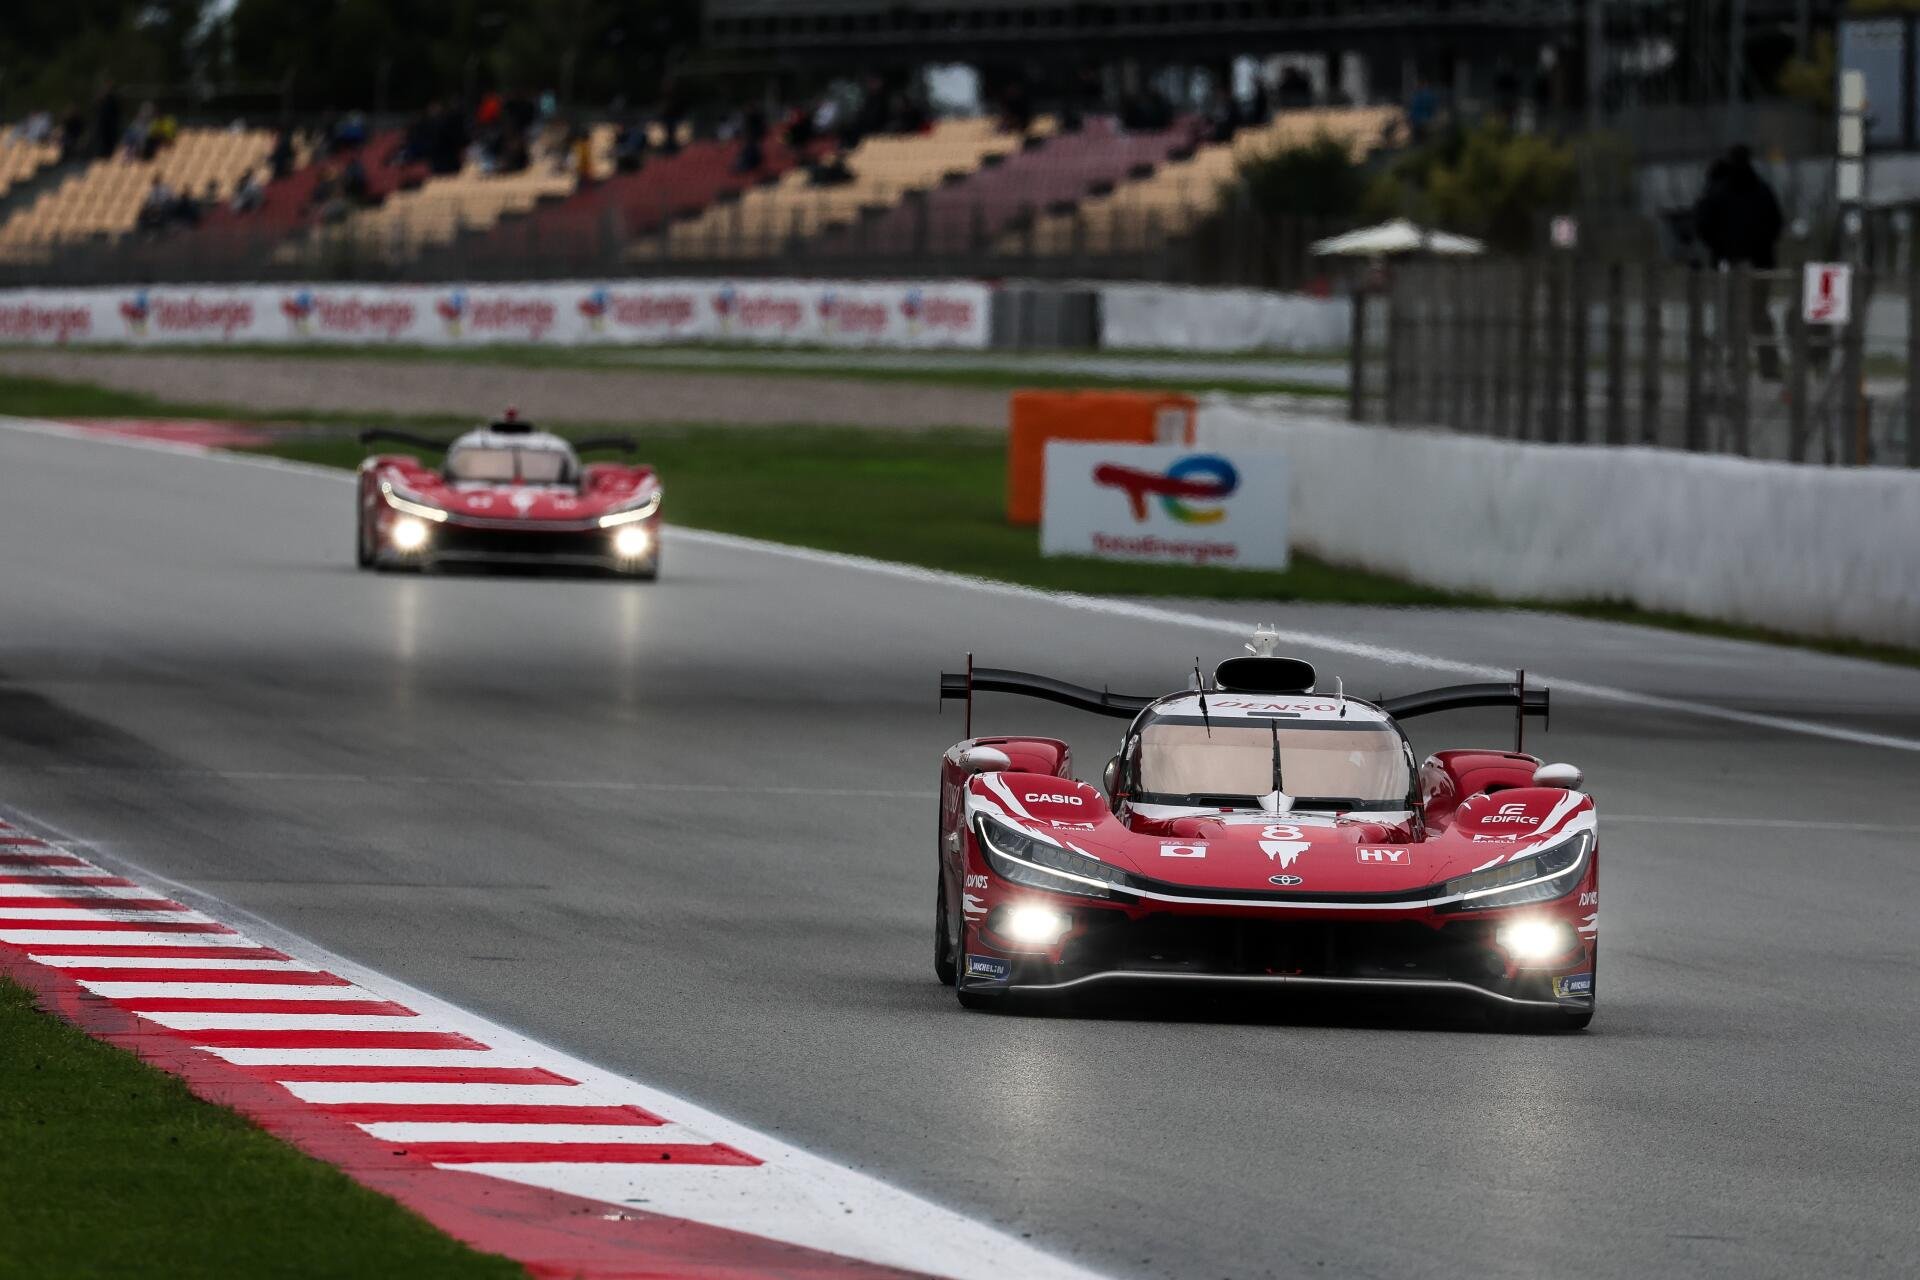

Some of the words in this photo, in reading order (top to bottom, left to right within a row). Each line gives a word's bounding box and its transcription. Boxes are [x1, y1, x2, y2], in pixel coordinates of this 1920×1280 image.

[1212, 701, 1336, 711] DENSO
[1025, 793, 1083, 806] CASIO
[1481, 815, 1540, 825] EDIFICE
[1262, 825, 1304, 840] 8
[1360, 849, 1405, 862] HY
[973, 962, 1004, 974] MICHELIN
